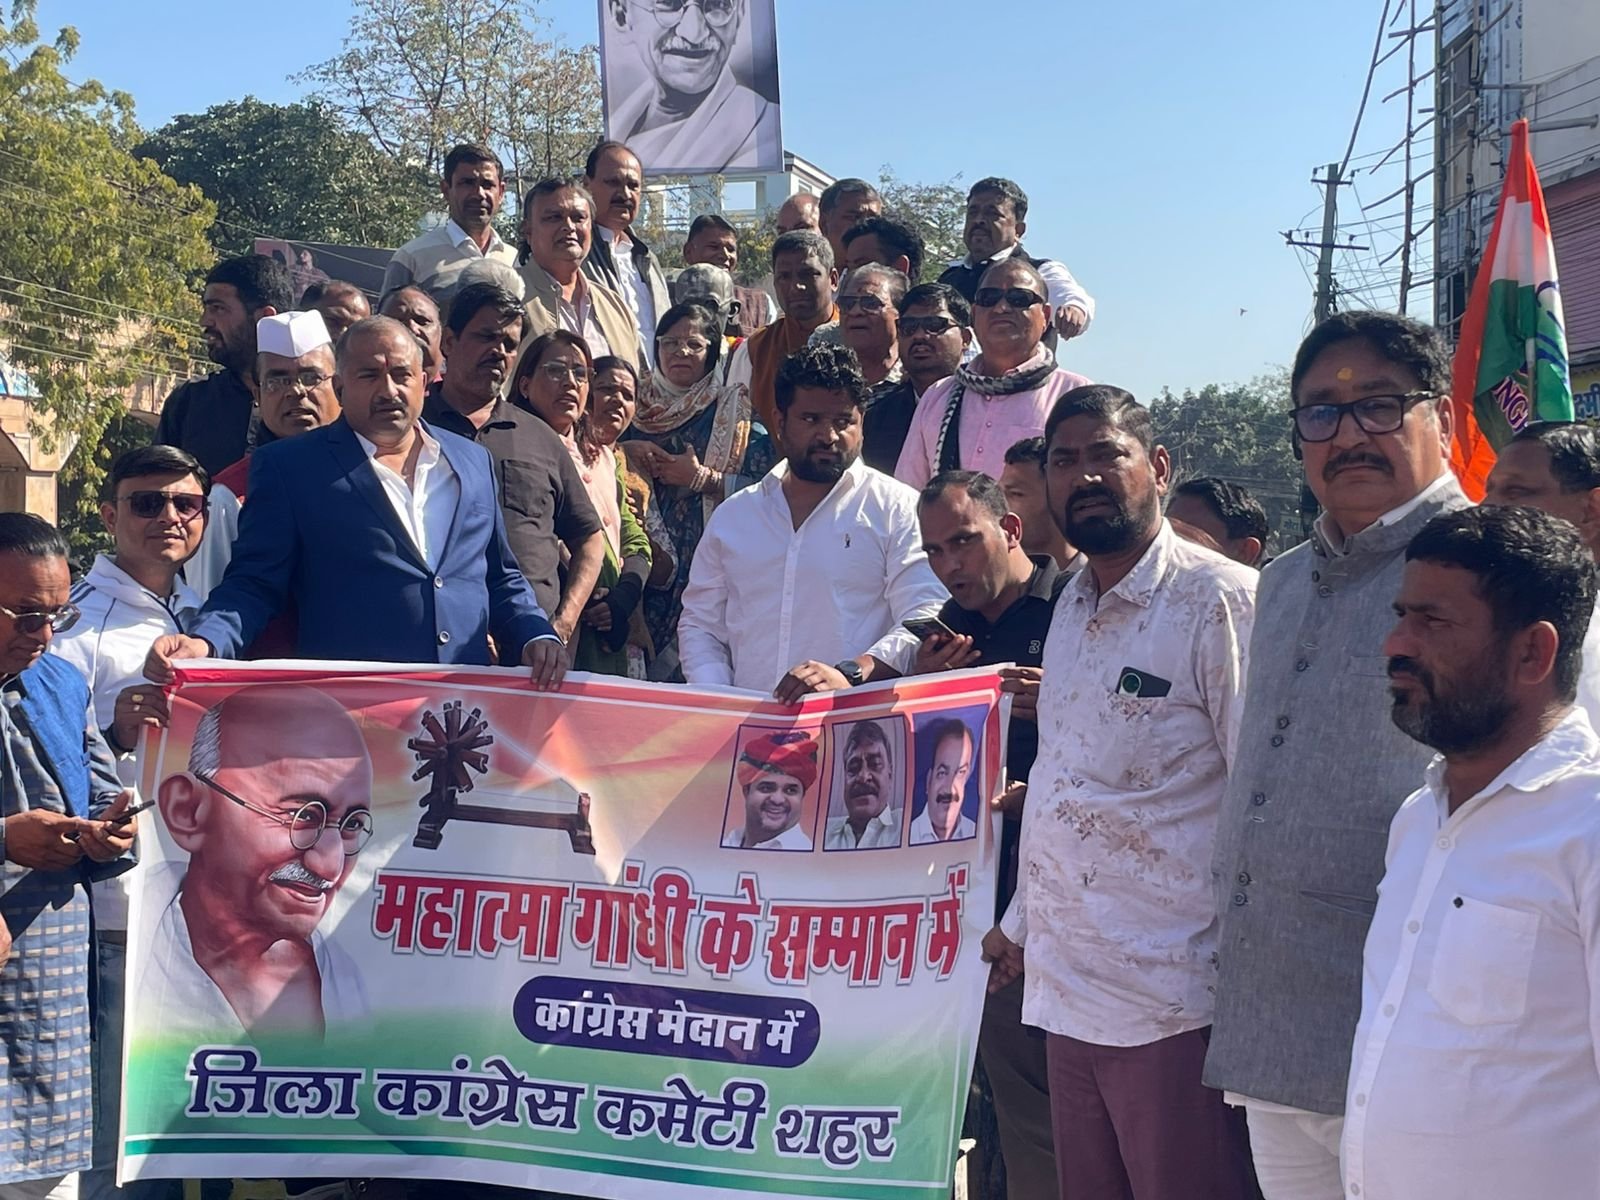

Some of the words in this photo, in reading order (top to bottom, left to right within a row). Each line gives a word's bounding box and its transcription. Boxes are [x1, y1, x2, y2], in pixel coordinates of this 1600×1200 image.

[373, 871, 571, 961] महात्मा
[573, 862, 698, 973] गांधी
[698, 874, 763, 977] के
[766, 900, 927, 984] सम्मान
[926, 864, 967, 979] में
[535, 990, 653, 1040] कांग्रेस
[765, 1009, 806, 1054] में
[186, 1047, 364, 1116] जिला
[375, 1057, 586, 1130] कांग्रेस
[596, 1075, 767, 1151] कमेटी
[774, 1108, 899, 1166] शहर
